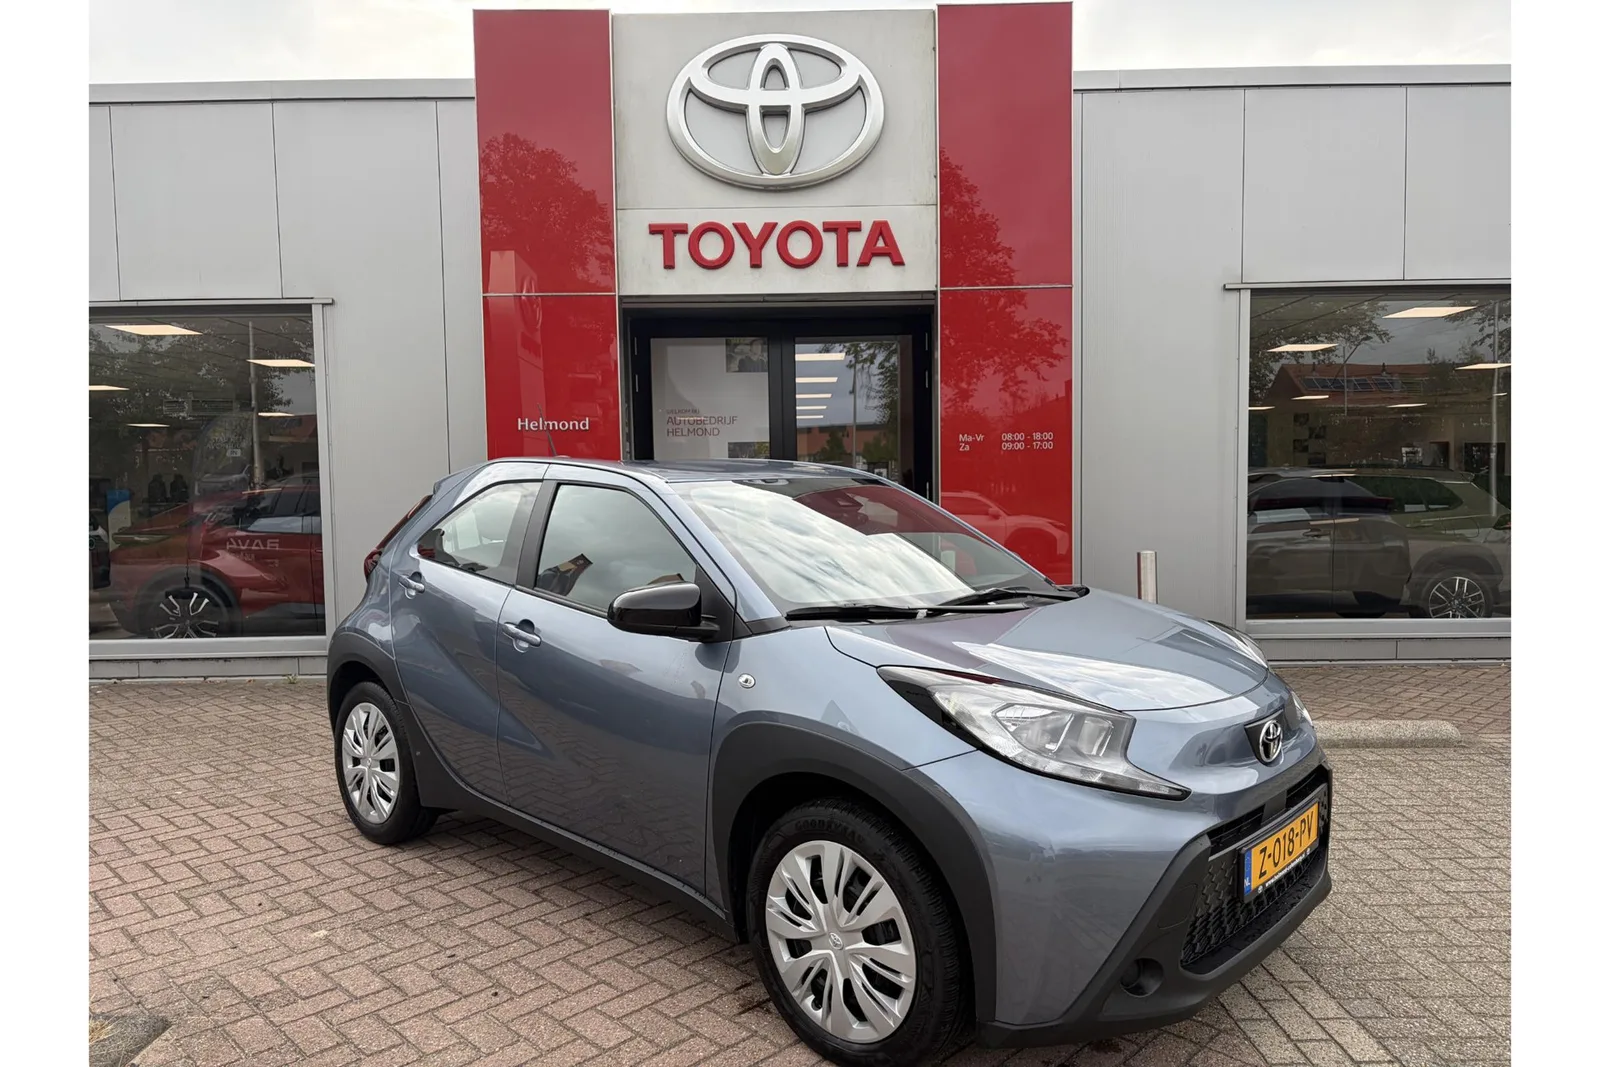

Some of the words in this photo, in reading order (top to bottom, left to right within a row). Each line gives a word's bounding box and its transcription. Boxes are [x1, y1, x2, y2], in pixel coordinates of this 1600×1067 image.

[648, 220, 905, 270] TOYOTA
[517, 416, 590, 431] Helmond
[666, 415, 738, 426] AUTOBEDRIJF
[666, 427, 721, 437] HELMOND
[958, 433, 985, 442] Ma-Vr
[1001, 432, 1025, 441] 08:00
[1032, 432, 1054, 441] 18:00
[959, 443, 970, 451] Za
[1001, 442, 1025, 450] 09:00
[1032, 441, 1054, 450] 17:00
[1258, 810, 1314, 880] Z-018-PV
[1243, 876, 1251, 887] NL
